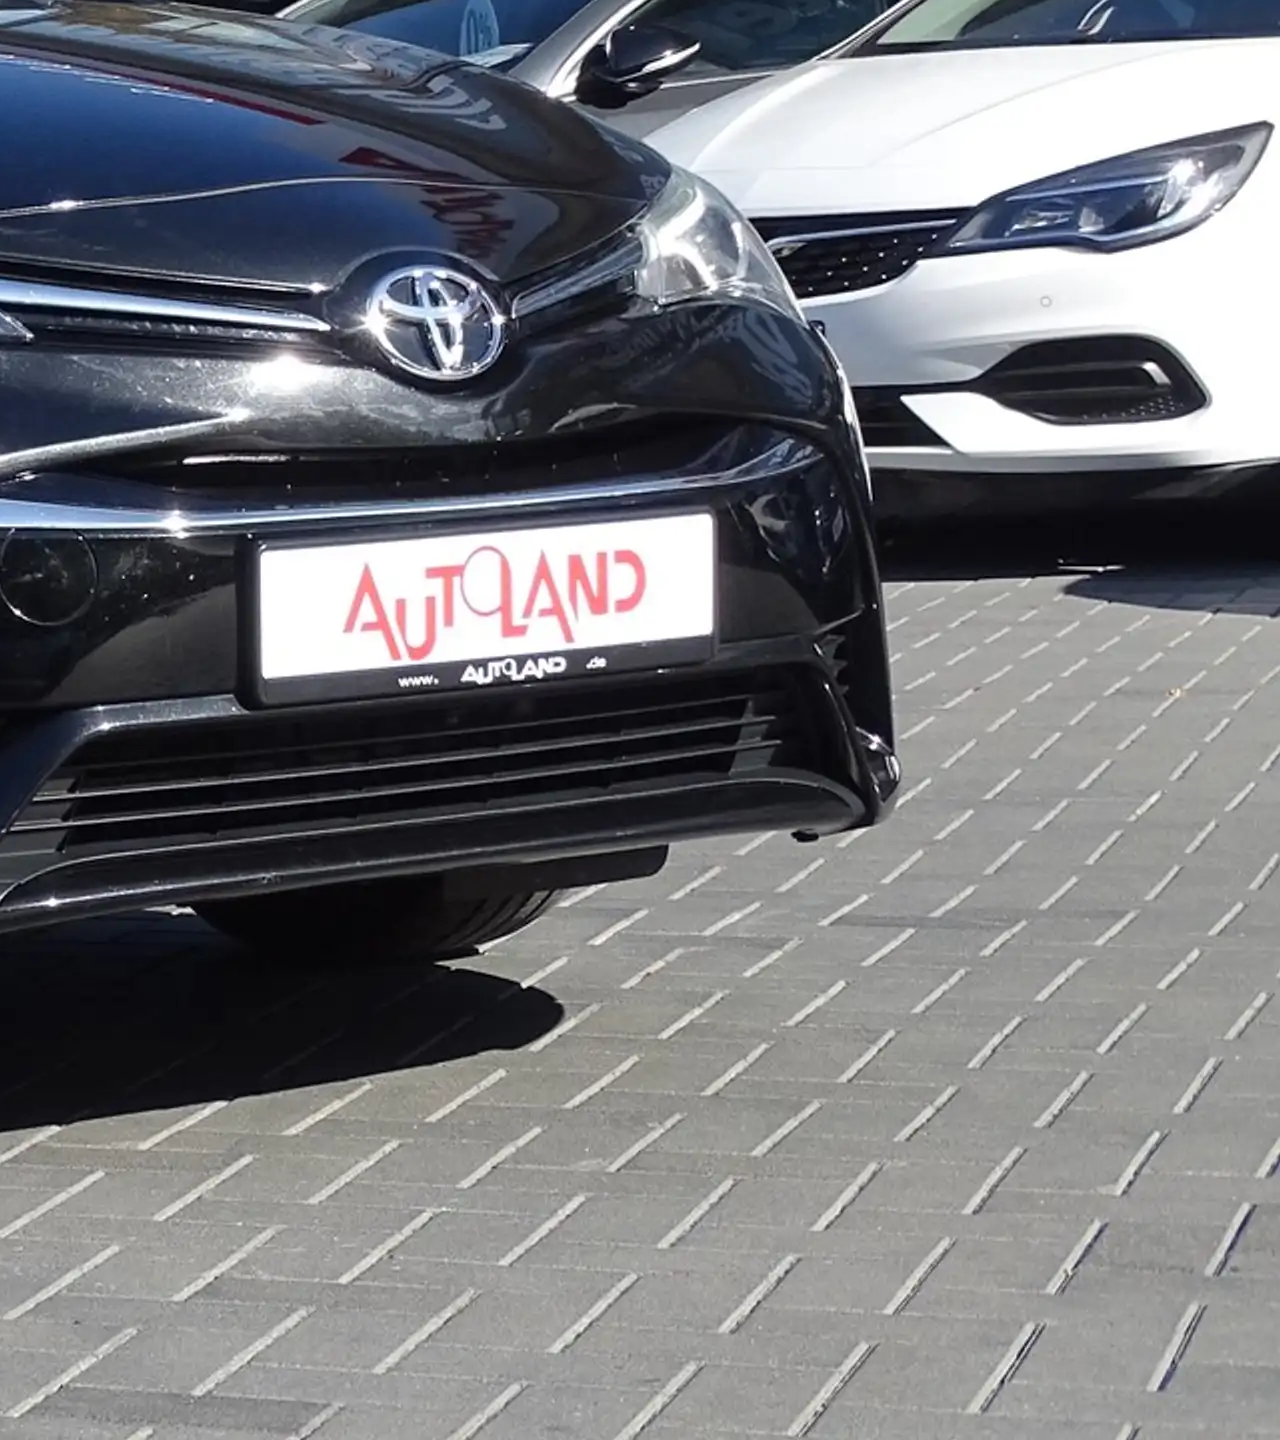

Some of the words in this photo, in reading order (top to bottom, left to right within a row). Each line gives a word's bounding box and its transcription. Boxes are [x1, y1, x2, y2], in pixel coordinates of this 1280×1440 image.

[342, 545, 647, 661] AUTOLAND
[398, 674, 439, 688] www.
[460, 656, 567, 685] AUTOLAND
[586, 656, 607, 670] .de
